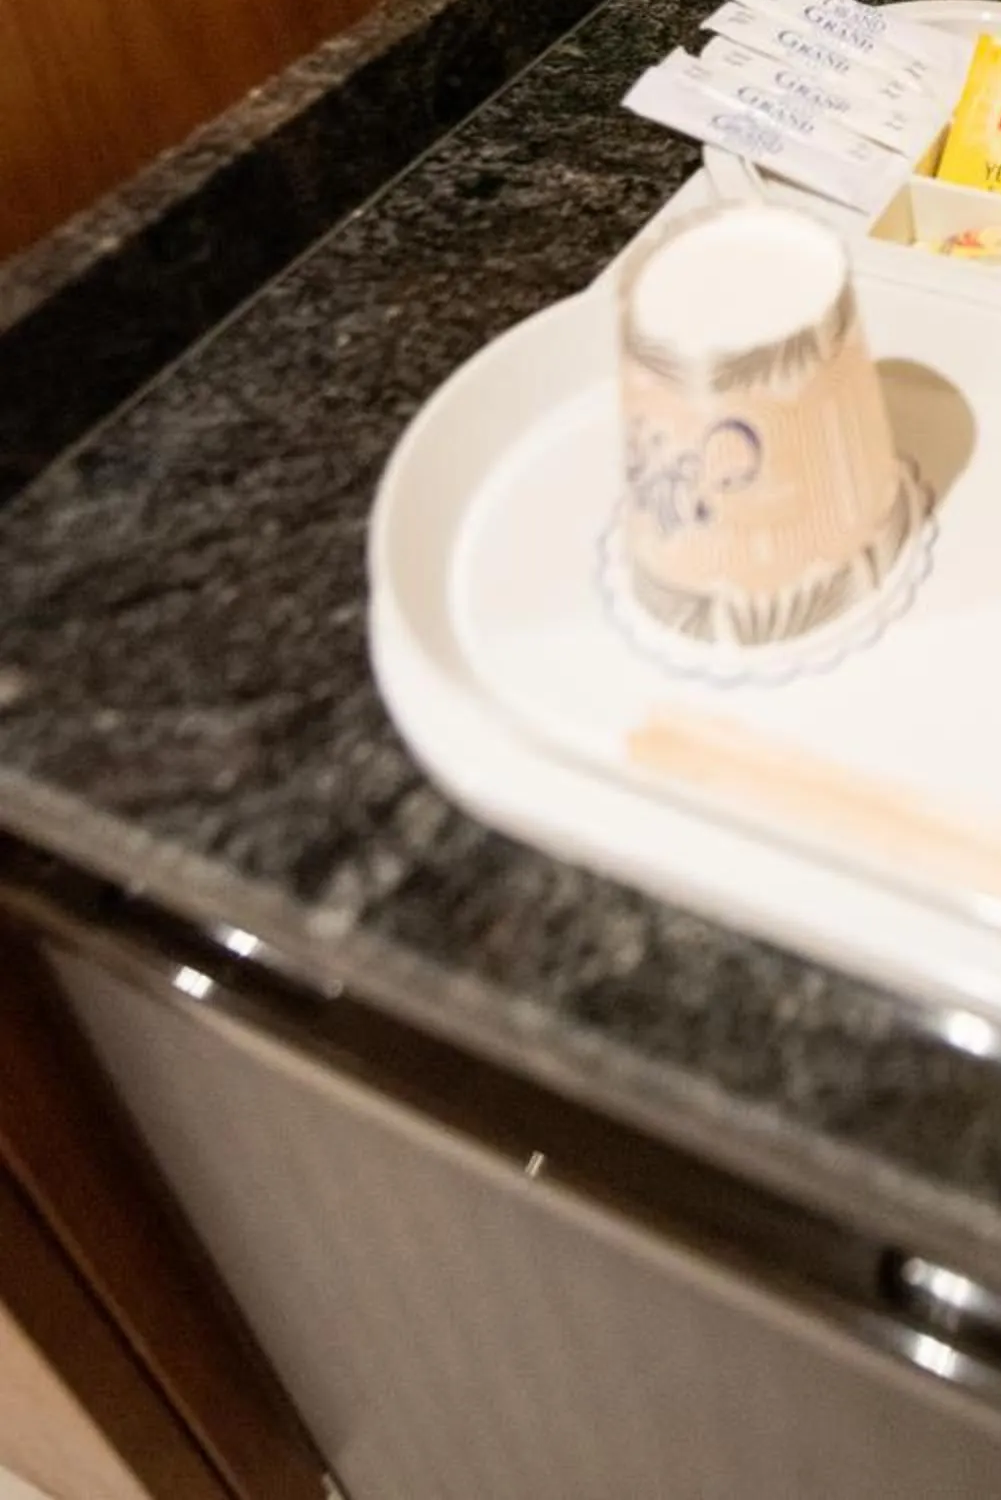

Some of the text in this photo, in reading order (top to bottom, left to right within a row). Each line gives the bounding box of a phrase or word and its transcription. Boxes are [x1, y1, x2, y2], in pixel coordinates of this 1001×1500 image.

[777, 30, 849, 73] GRAND
[804, 5, 874, 52] GRAND
[737, 85, 815, 135] GRAND
